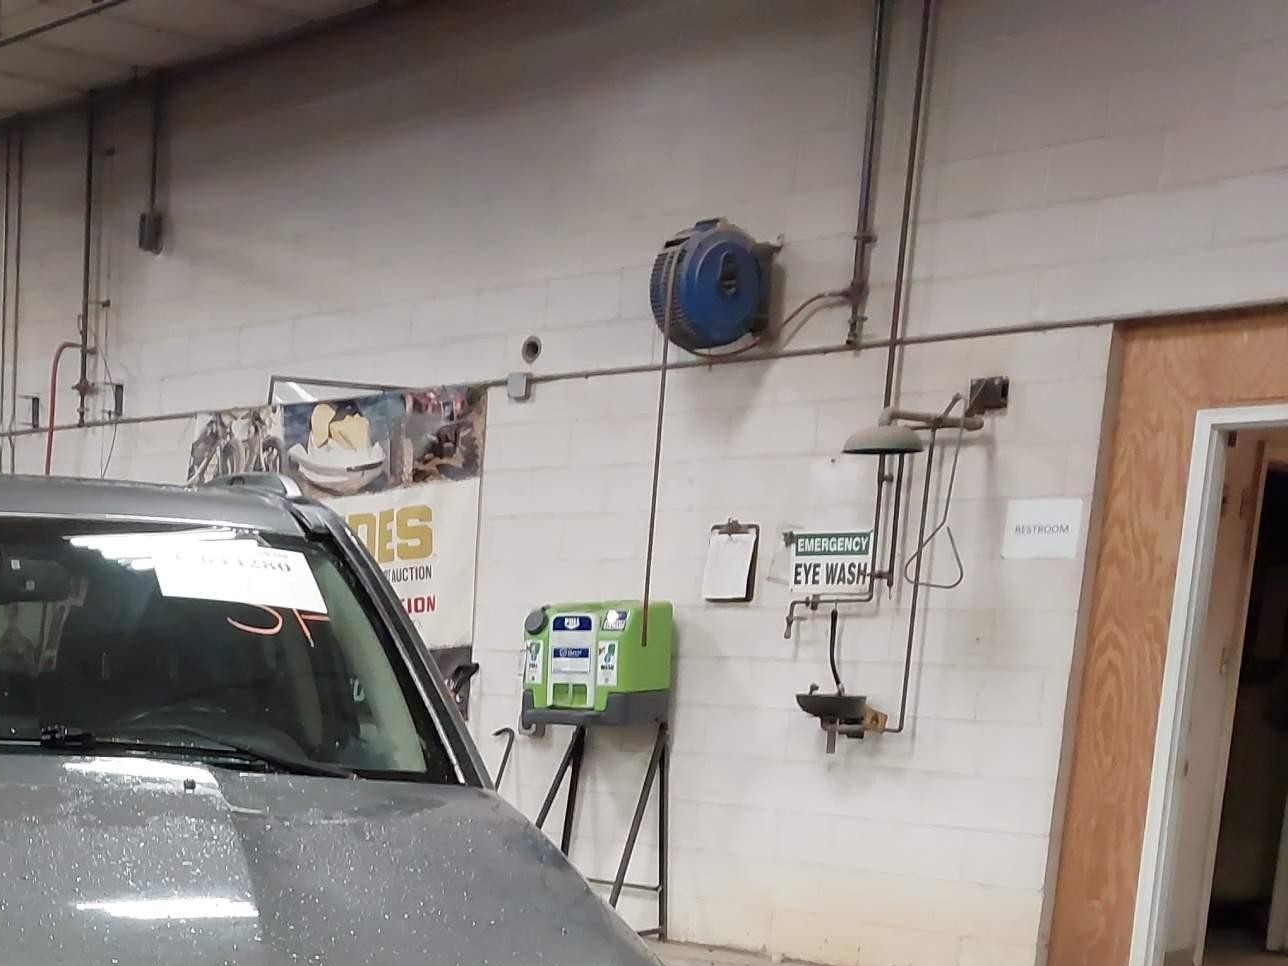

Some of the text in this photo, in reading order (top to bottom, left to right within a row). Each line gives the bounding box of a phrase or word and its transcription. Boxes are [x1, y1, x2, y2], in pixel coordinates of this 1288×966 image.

[1014, 524, 1070, 535] RESTROOM
[797, 536, 869, 553] EMERGENCY
[391, 564, 433, 583] AUCTION
[793, 561, 868, 585] EYE WASH
[401, 595, 436, 614] ION
